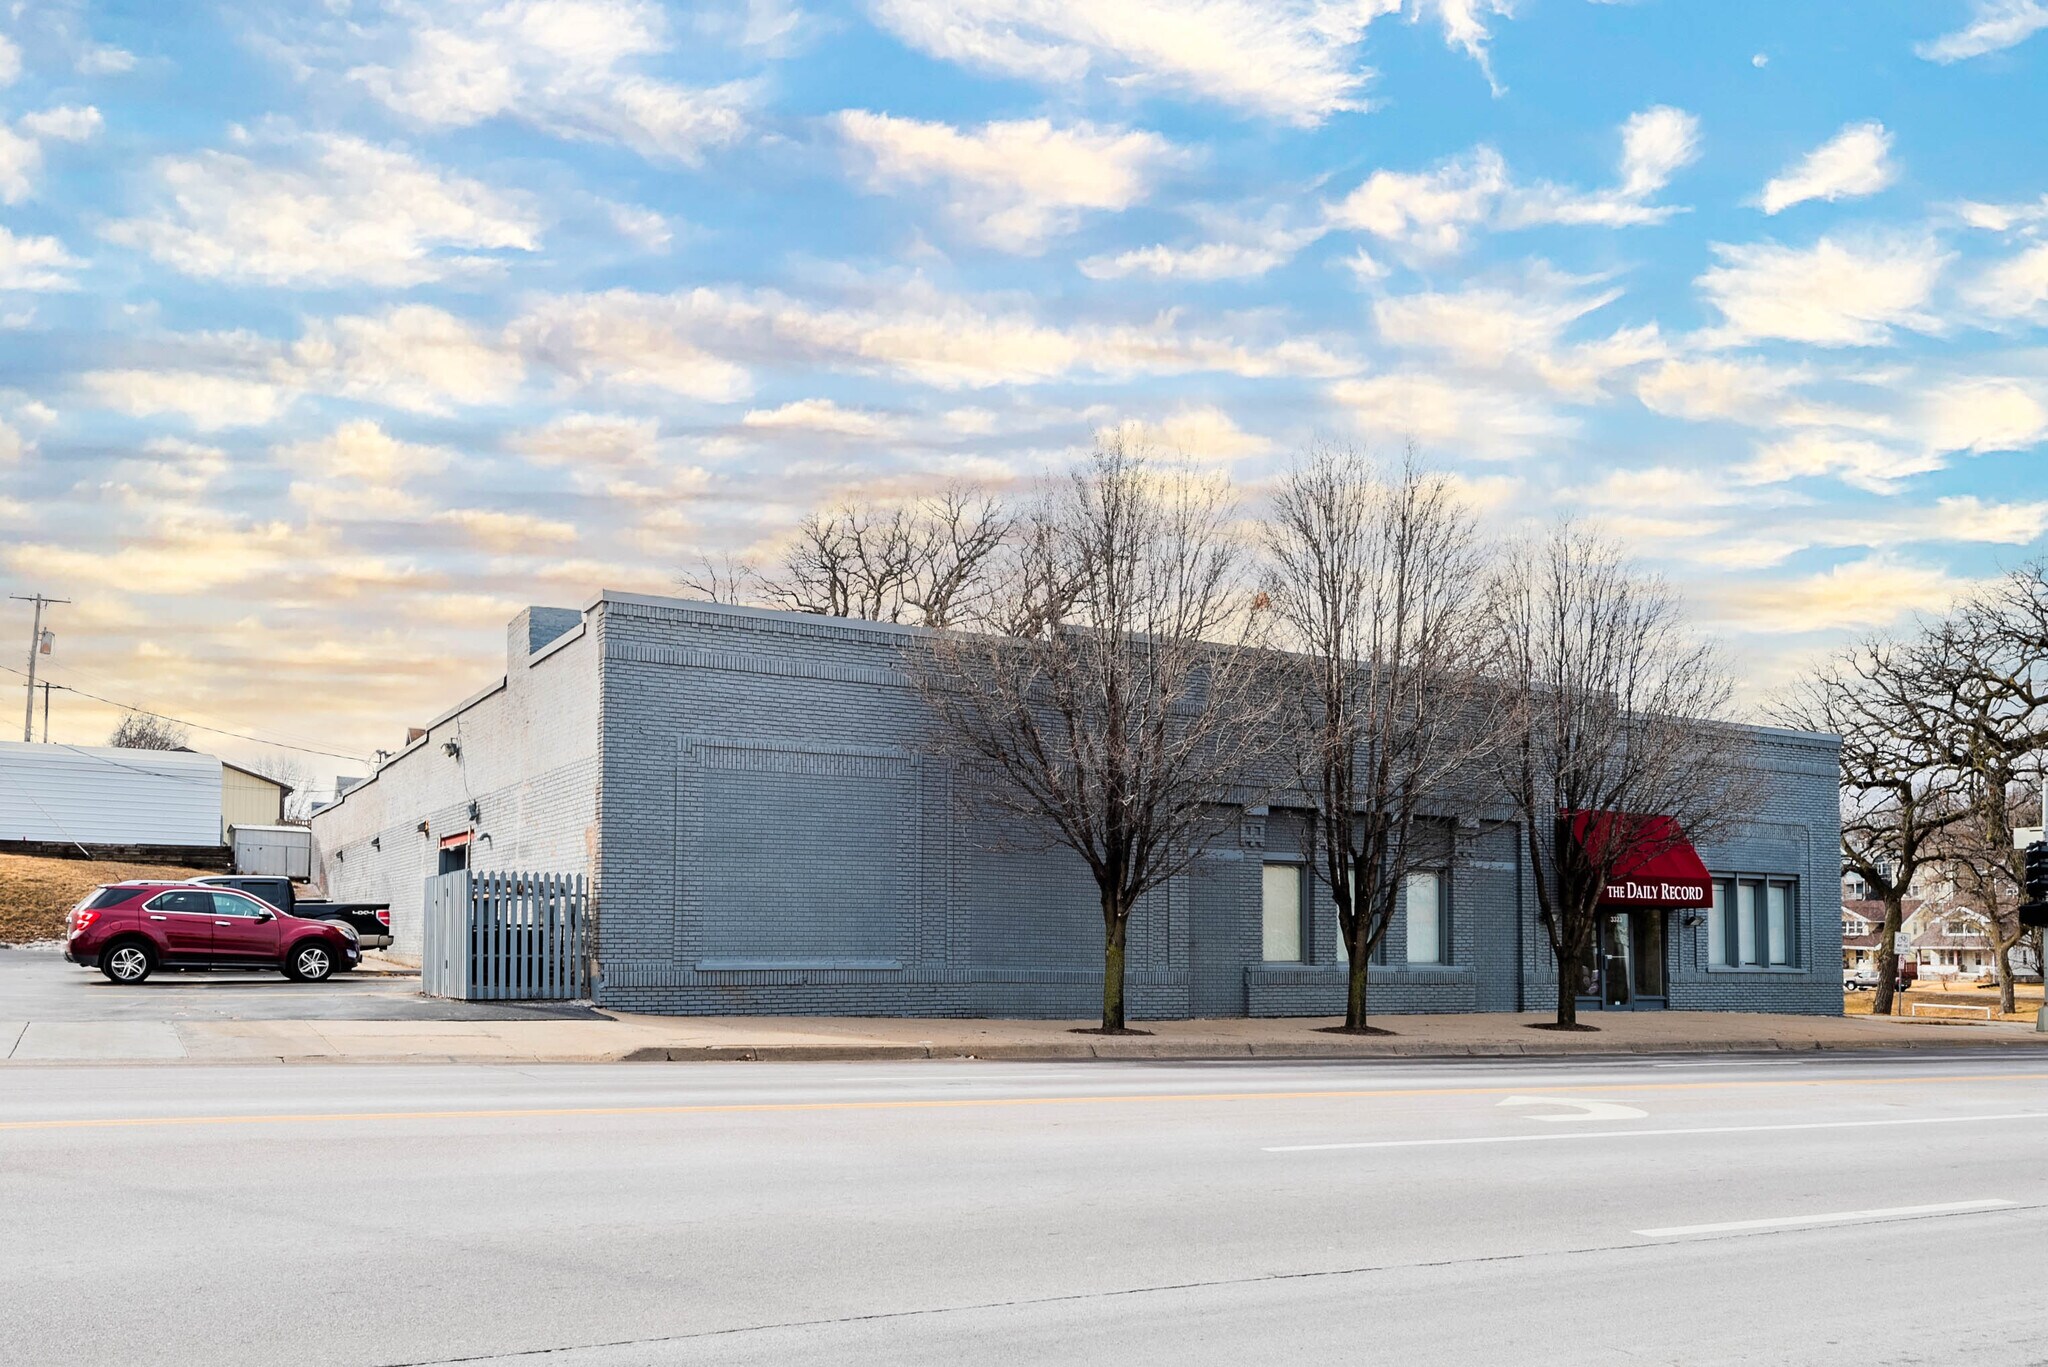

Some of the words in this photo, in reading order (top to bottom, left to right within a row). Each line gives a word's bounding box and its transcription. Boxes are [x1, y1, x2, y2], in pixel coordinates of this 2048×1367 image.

[1607, 886, 1625, 898] THE
[1626, 882, 1658, 899] DAILY
[1661, 883, 1703, 900] RECORD
